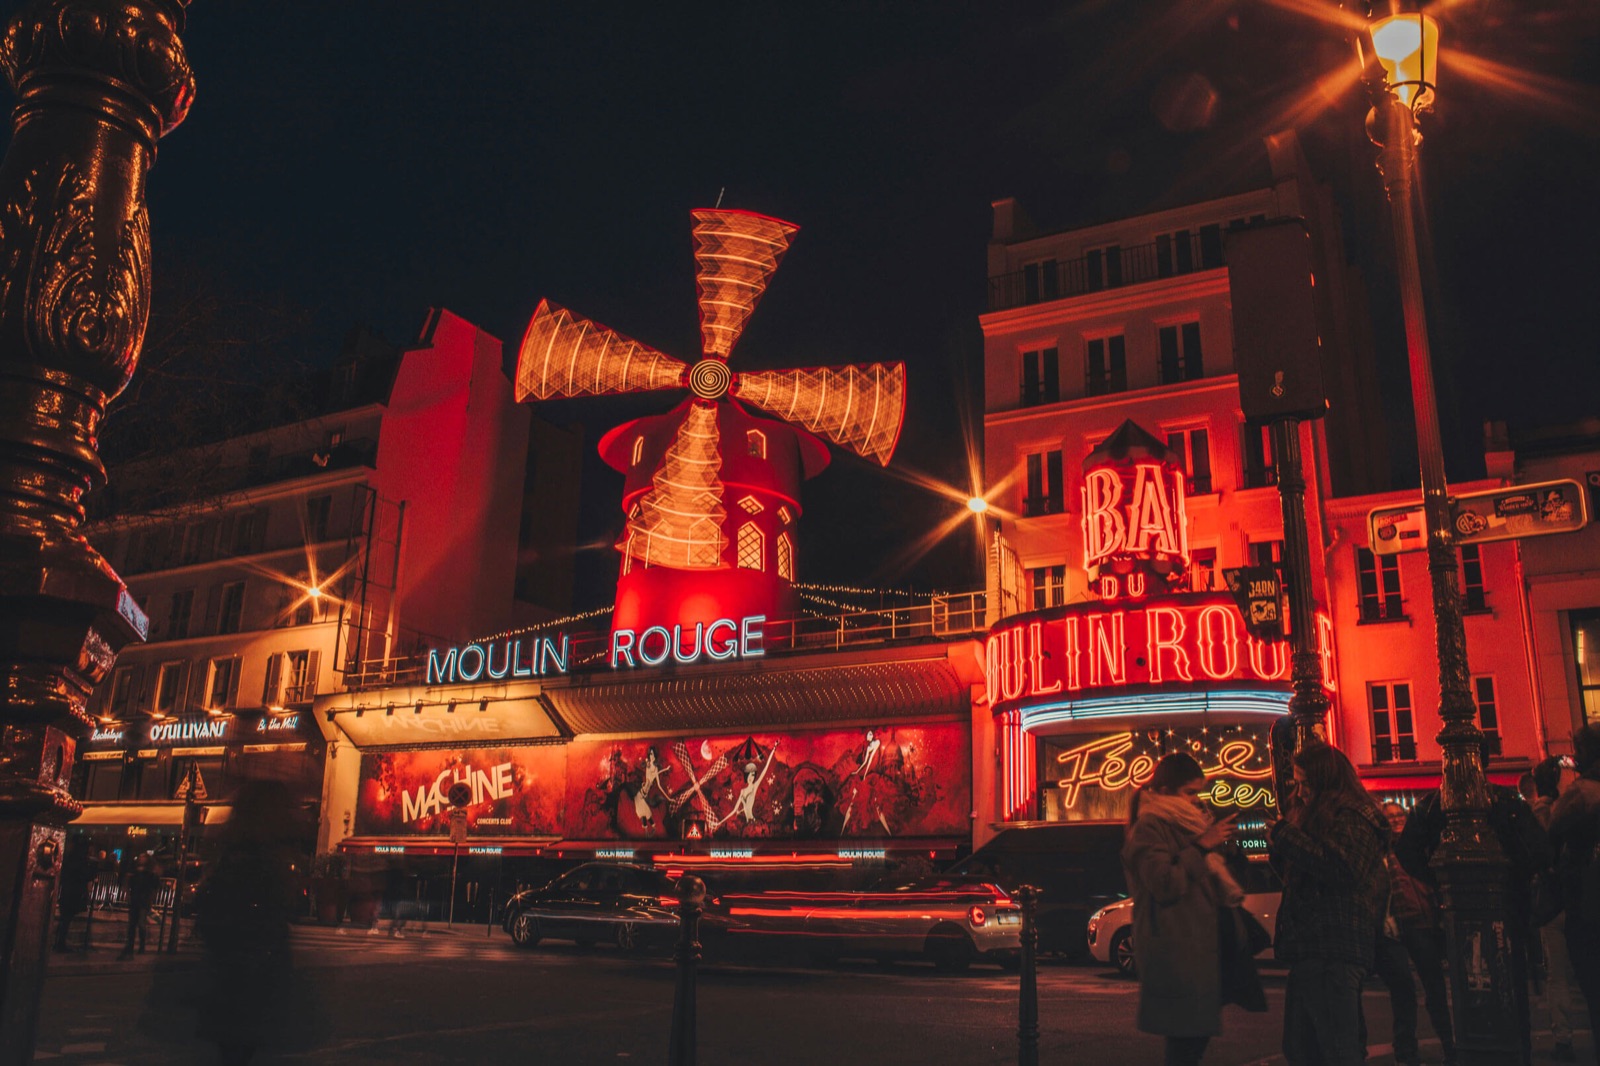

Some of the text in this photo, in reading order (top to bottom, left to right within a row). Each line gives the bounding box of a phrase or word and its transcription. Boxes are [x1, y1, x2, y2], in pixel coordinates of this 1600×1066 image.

[1102, 573, 1144, 599] DU
[427, 615, 766, 684] MOULIN ROUGE
[1146, 605, 1336, 692] ROUE
[268, 717, 280, 730] the
[91, 728, 123, 743] Backstage
[710, 850, 752, 858] MOULIN ROUGE
[838, 850, 885, 858] MOULIN ROUGE
